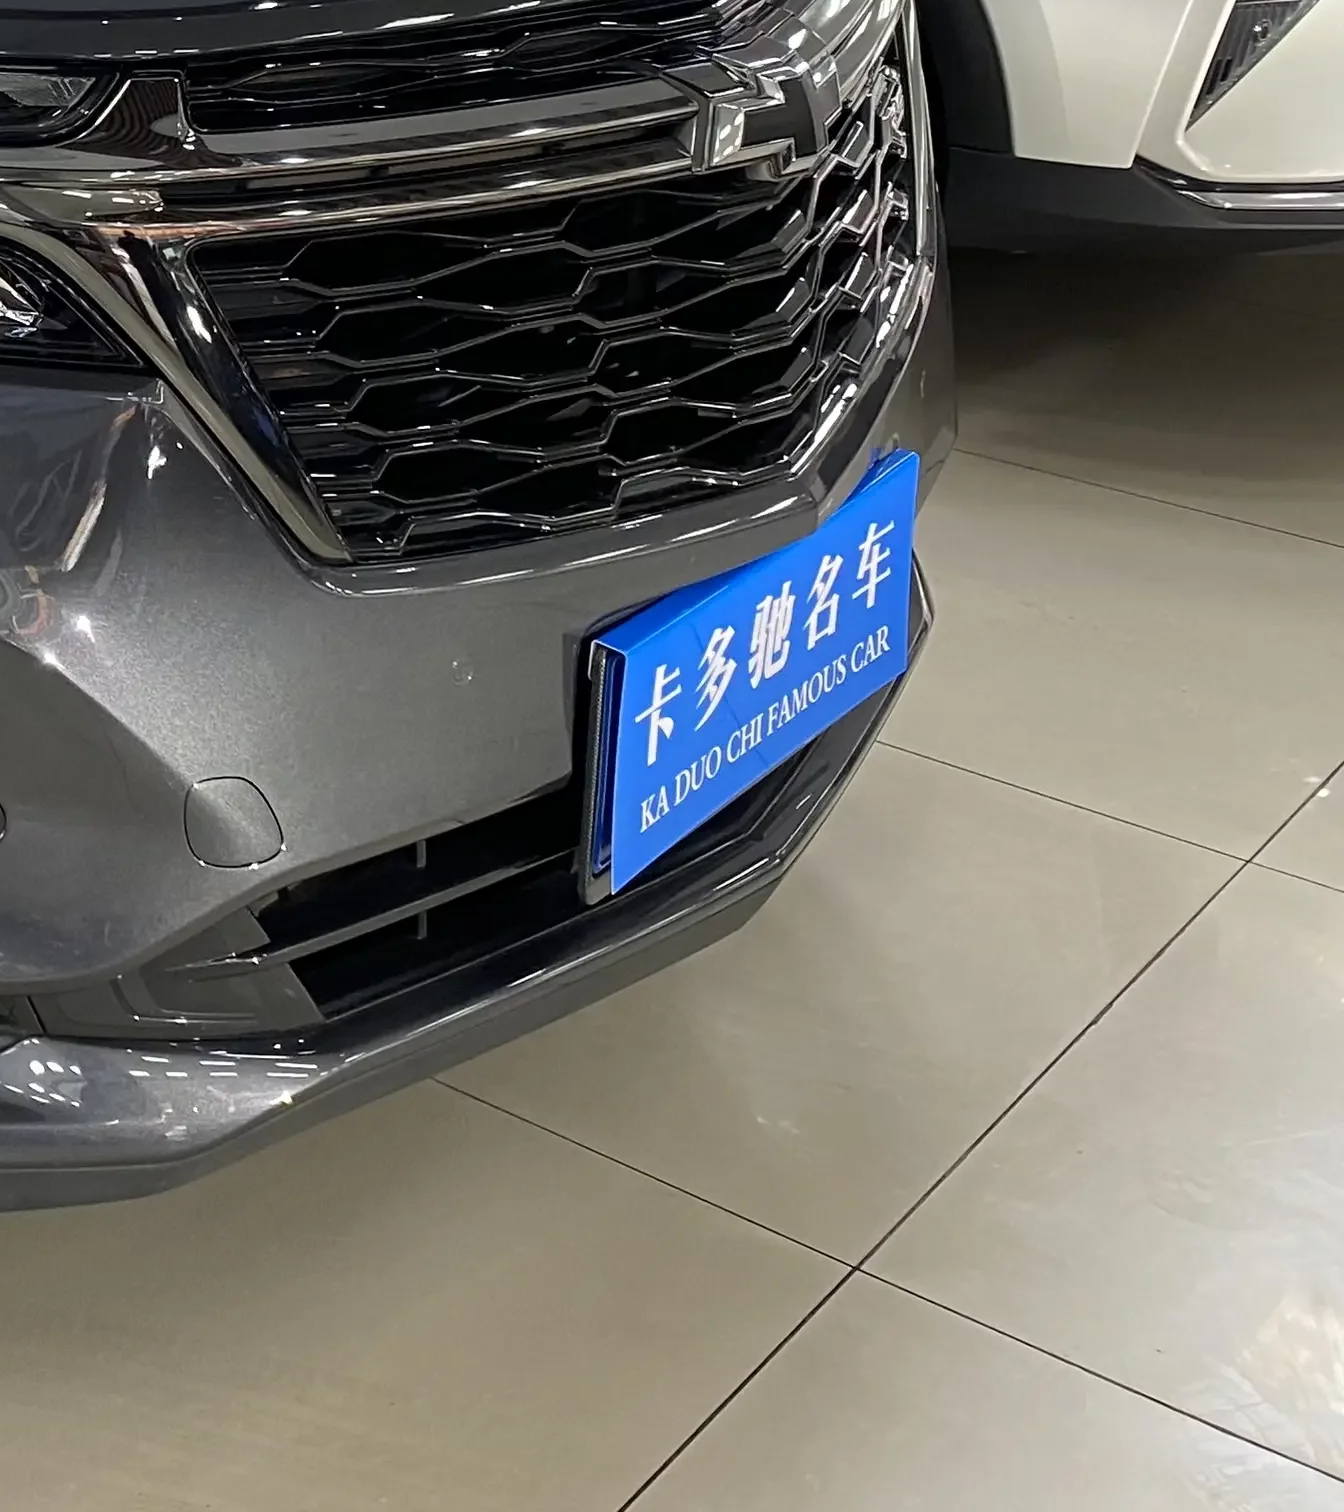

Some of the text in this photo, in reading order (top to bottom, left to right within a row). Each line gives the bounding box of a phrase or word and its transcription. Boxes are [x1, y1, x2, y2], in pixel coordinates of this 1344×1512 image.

[633, 518, 896, 768] 卡多驰名车
[639, 624, 892, 834] KA DUO CHI FAMOUS CAR
